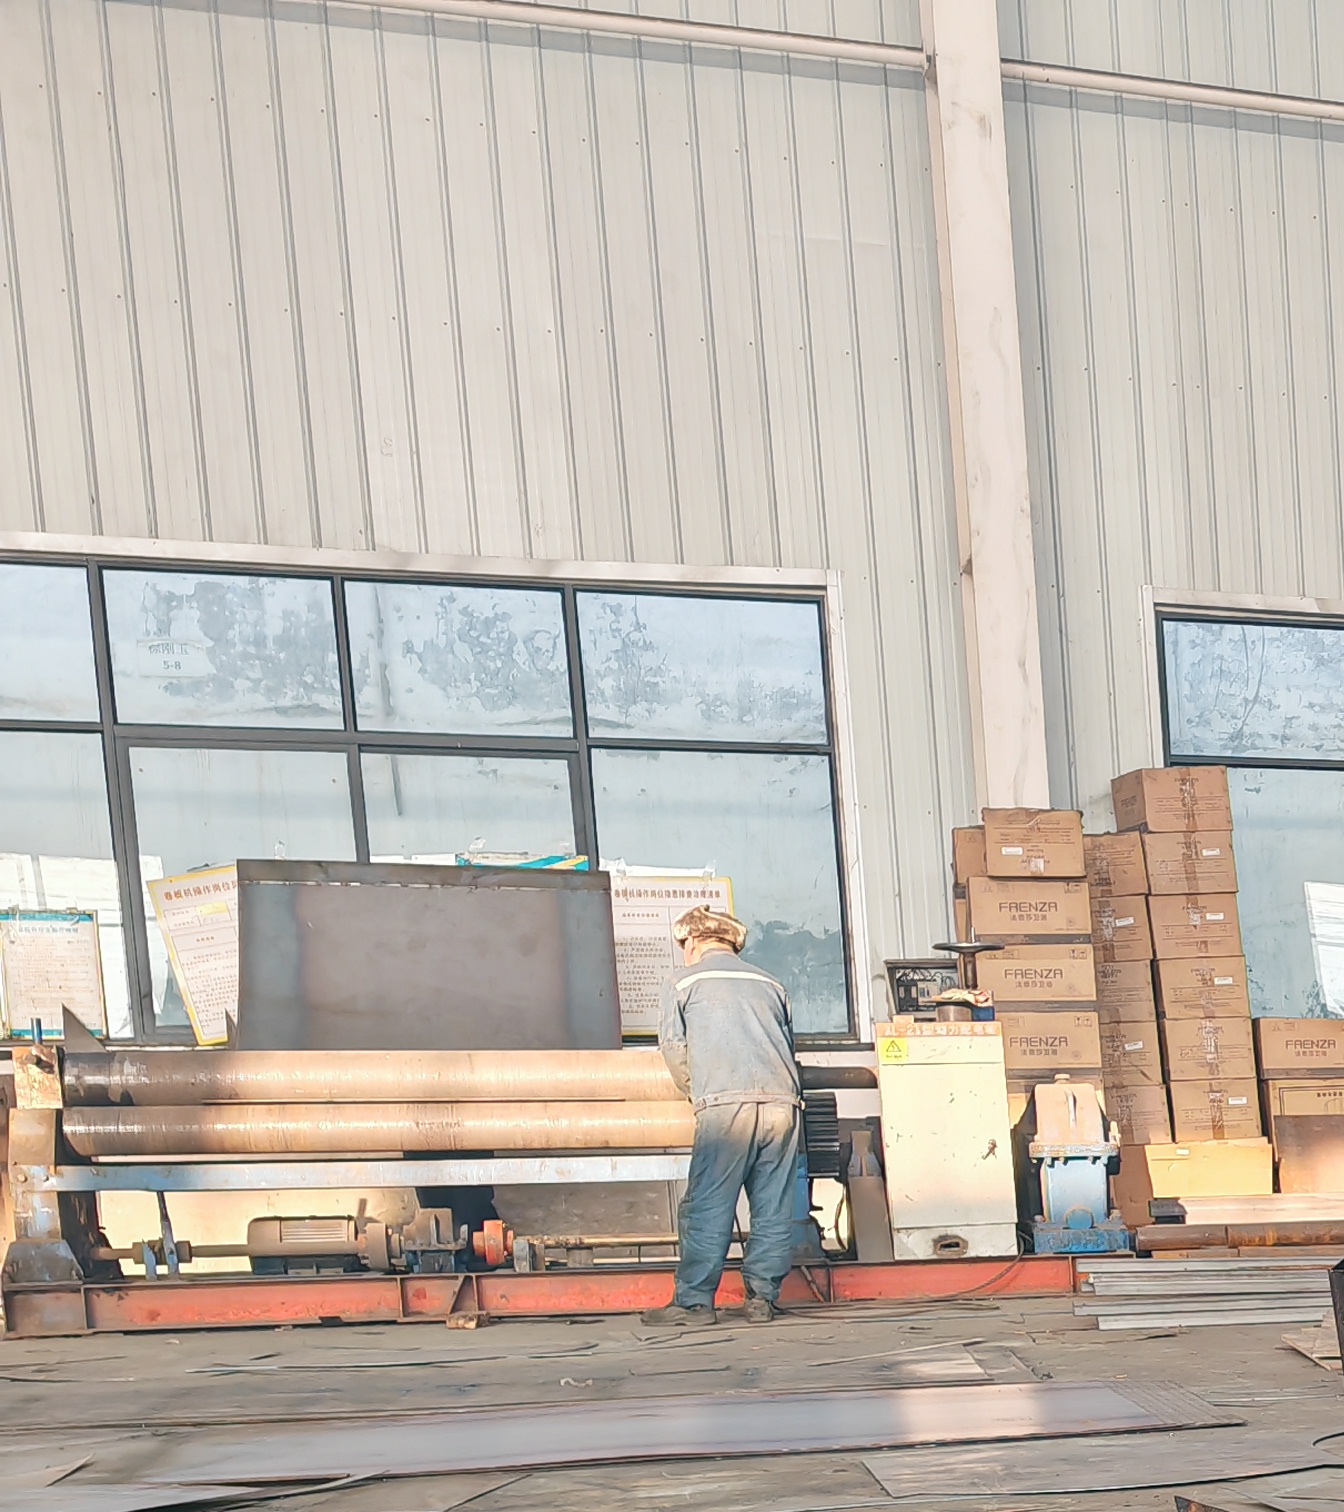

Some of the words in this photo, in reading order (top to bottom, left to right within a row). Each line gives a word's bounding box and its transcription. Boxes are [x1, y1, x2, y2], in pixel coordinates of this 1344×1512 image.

[998, 901, 1058, 913] FAENZA
[1004, 968, 1063, 979] FAENZA
[1009, 1036, 1068, 1047] FAENZA
[1285, 1039, 1337, 1050] FAENZA
